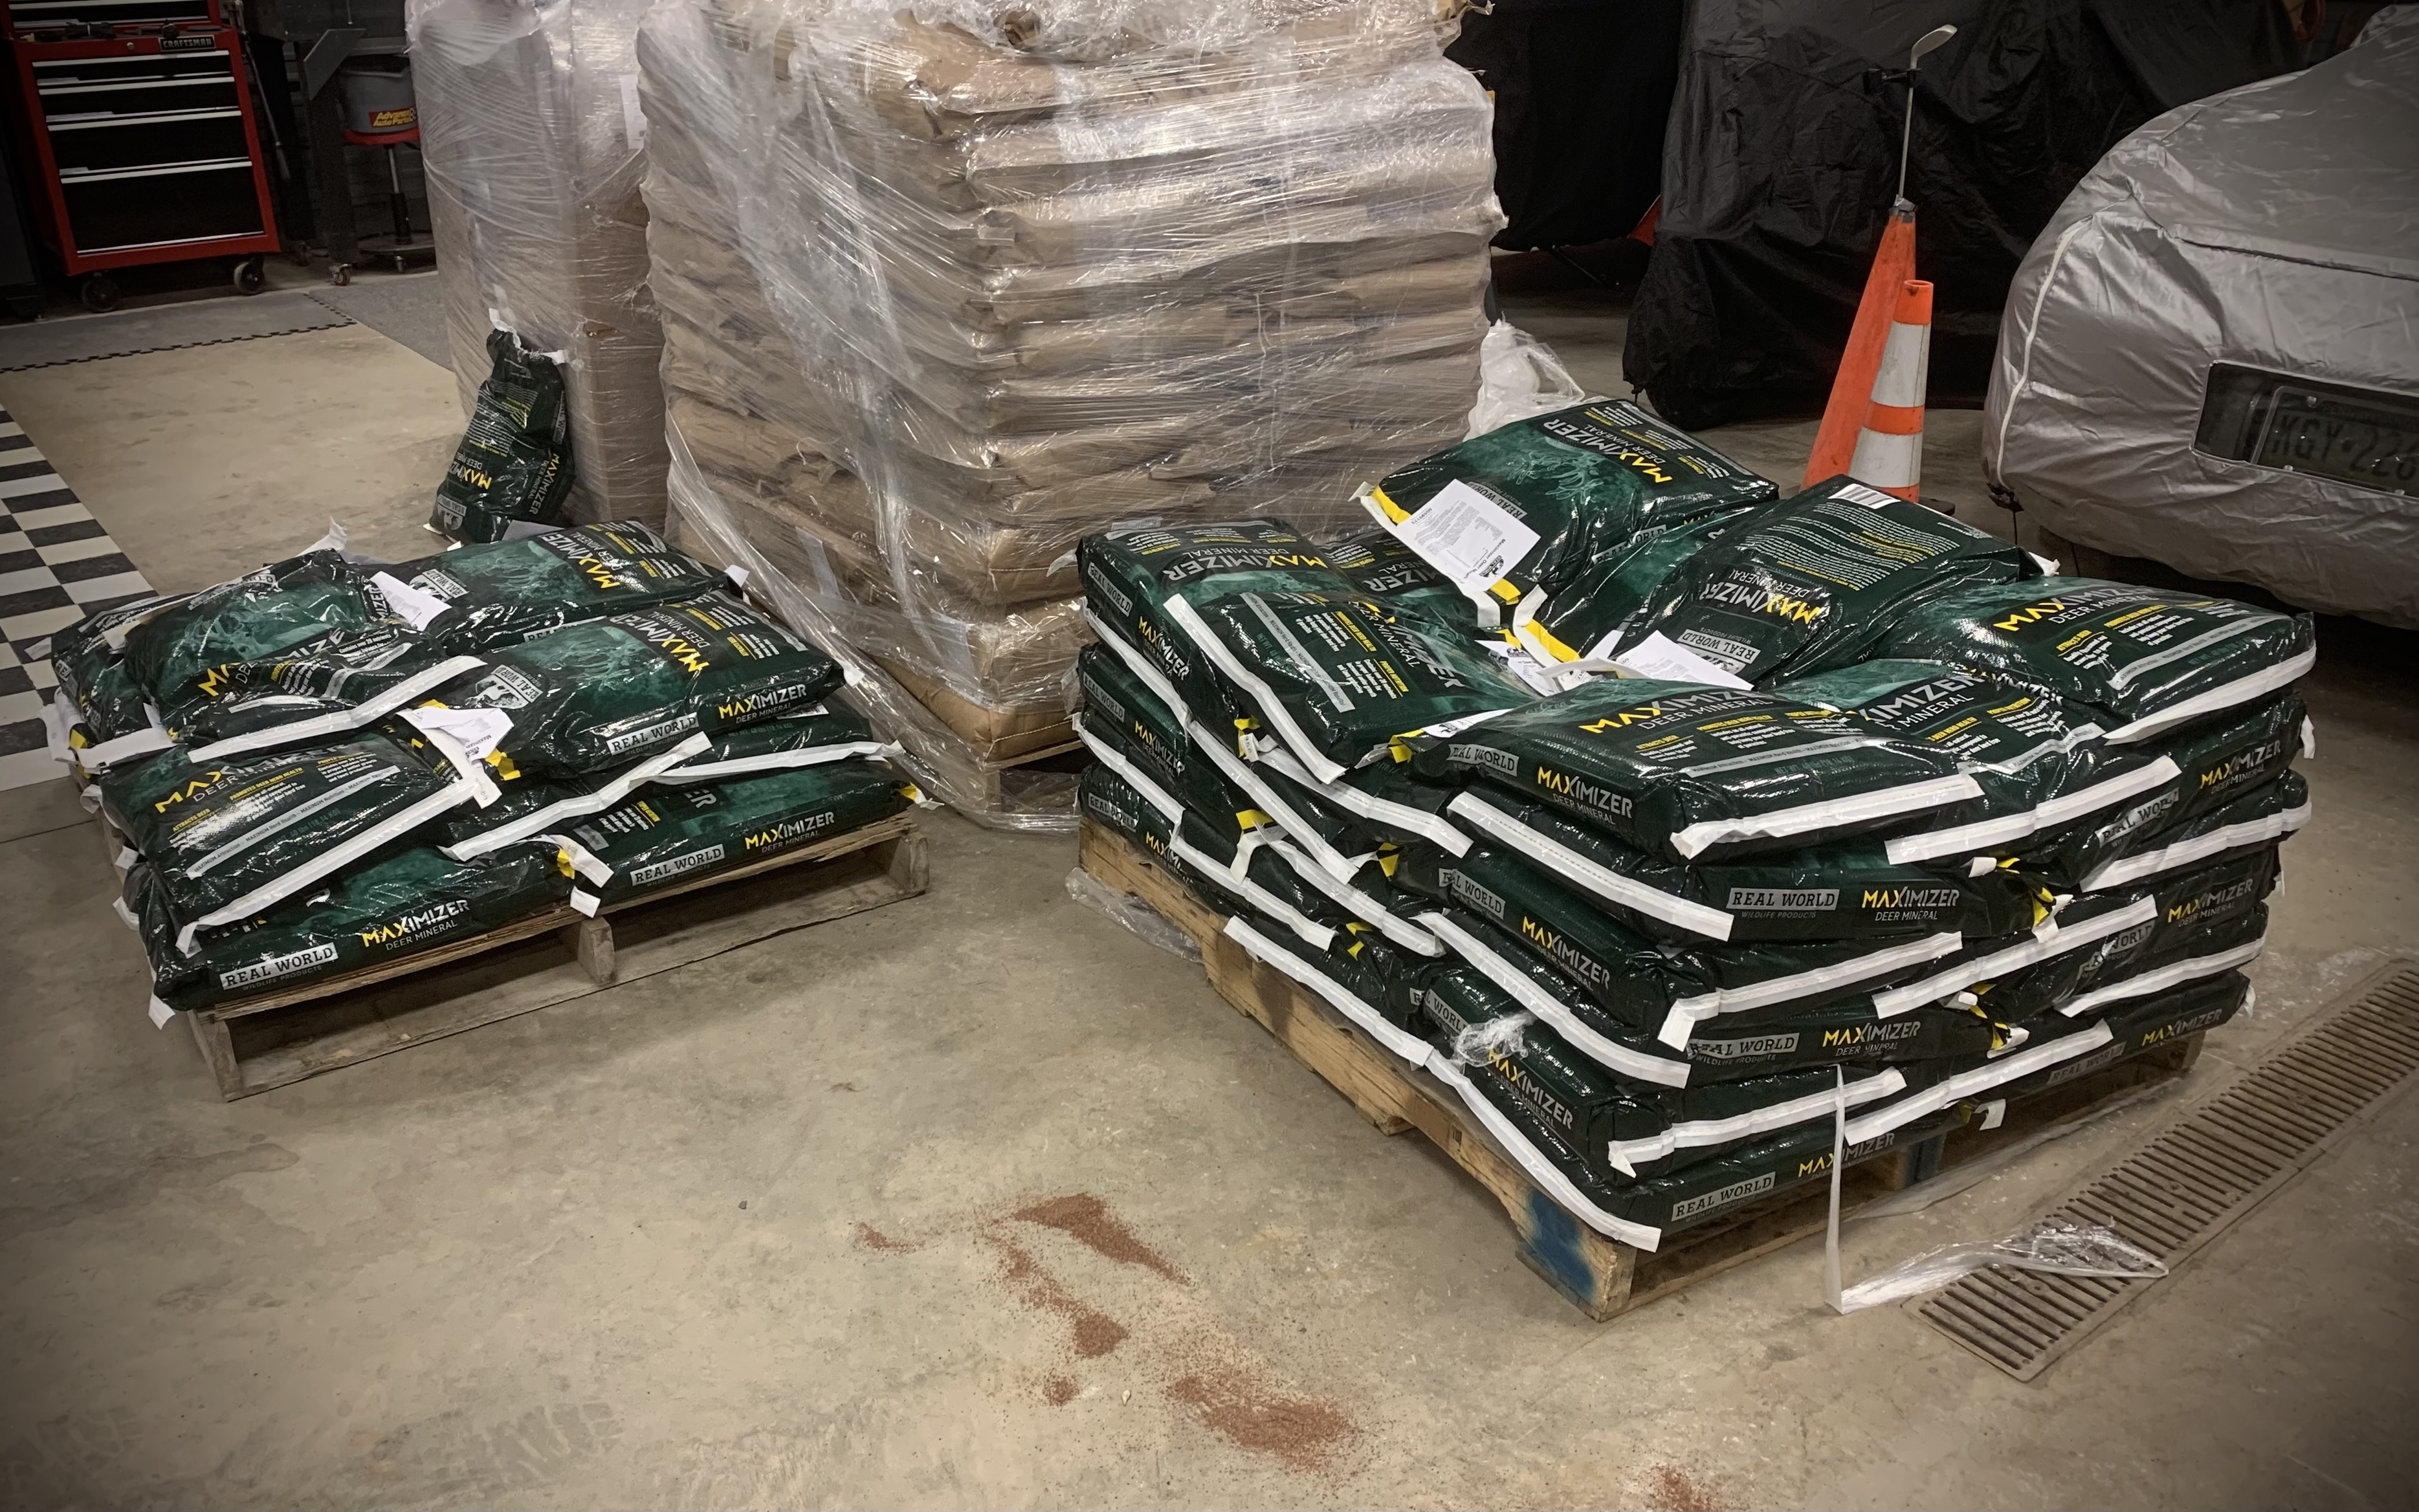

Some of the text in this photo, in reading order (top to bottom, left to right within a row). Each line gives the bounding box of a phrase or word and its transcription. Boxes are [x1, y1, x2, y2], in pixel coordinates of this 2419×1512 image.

[163, 38, 212, 48] CRAFTSMAN
[1584, 424, 1631, 447] MINERAL
[1543, 419, 1673, 483] MAXIMIZER
[1633, 446, 1666, 464] DEER
[1162, 555, 1329, 581] MAXIMIZER
[1182, 547, 1249, 559] MINERAL
[1107, 582, 1131, 612] WORLD
[1776, 582, 1811, 598] DEER
[2049, 594, 2159, 624] DEER MINERAL
[647, 611, 711, 648] DEER MINERAL
[1373, 623, 1421, 668] MINERAL
[1682, 631, 1757, 661] REAL WORLD
[516, 679, 540, 700] REAL
[718, 684, 807, 719] MAXIMIZER
[736, 703, 791, 723] DEER MINERAL
[1100, 693, 1124, 718] WORLD
[1638, 698, 1774, 730] DEER MINERAL
[1897, 694, 1975, 727] MINERAL
[613, 716, 696, 752] REAL WORLD
[1475, 748, 1515, 772] WORLD
[2200, 739, 2281, 789] MAXIMIZER
[193, 775, 239, 802] DEER
[1538, 766, 1633, 818] MAXIMIZER
[2211, 780, 2231, 794] DEER
[1089, 796, 1109, 814] REAL
[1552, 792, 1616, 826] DEER MINERAL
[194, 855, 217, 873] MAXIMUM
[245, 827, 269, 843] MAXIMUM
[300, 799, 324, 815] MAXIMUM
[348, 777, 371, 790] MAXIMUM
[745, 811, 835, 850] MAXIMIZER
[761, 831, 820, 853] DEER MINERAL
[635, 848, 722, 884] REAL WORLD
[1464, 880, 1502, 914] WORLD
[1733, 892, 1836, 906] REAL WORLD
[1861, 886, 1961, 908] MAXIMIZER
[2168, 879, 2253, 923] MAXIMIZER
[2200, 902, 2237, 919] MINERAL
[361, 899, 471, 948] MAXIMIZER
[1875, 910, 1939, 921] DEER MINERAL
[386, 920, 458, 951] DEER MINERAL
[225, 947, 334, 987] REAL WORLD
[1523, 915, 1610, 990] MAXIMIZER
[243, 965, 322, 991] WILDLIFE PRODUCTS
[1822, 1022, 1921, 1047] MAXIMIZER
[2141, 1008, 2223, 1047] MAXIMIZER
[1740, 1036, 1795, 1053] WORLD
[1835, 1046, 1861, 1057] DEER
[1696, 1054, 1733, 1066] WILDLIFE
[1499, 1073, 1556, 1129] DEER MINERAL
[1675, 1176, 1773, 1218] REAL WORLD
[1685, 1209, 1716, 1223] WILDLIFE
